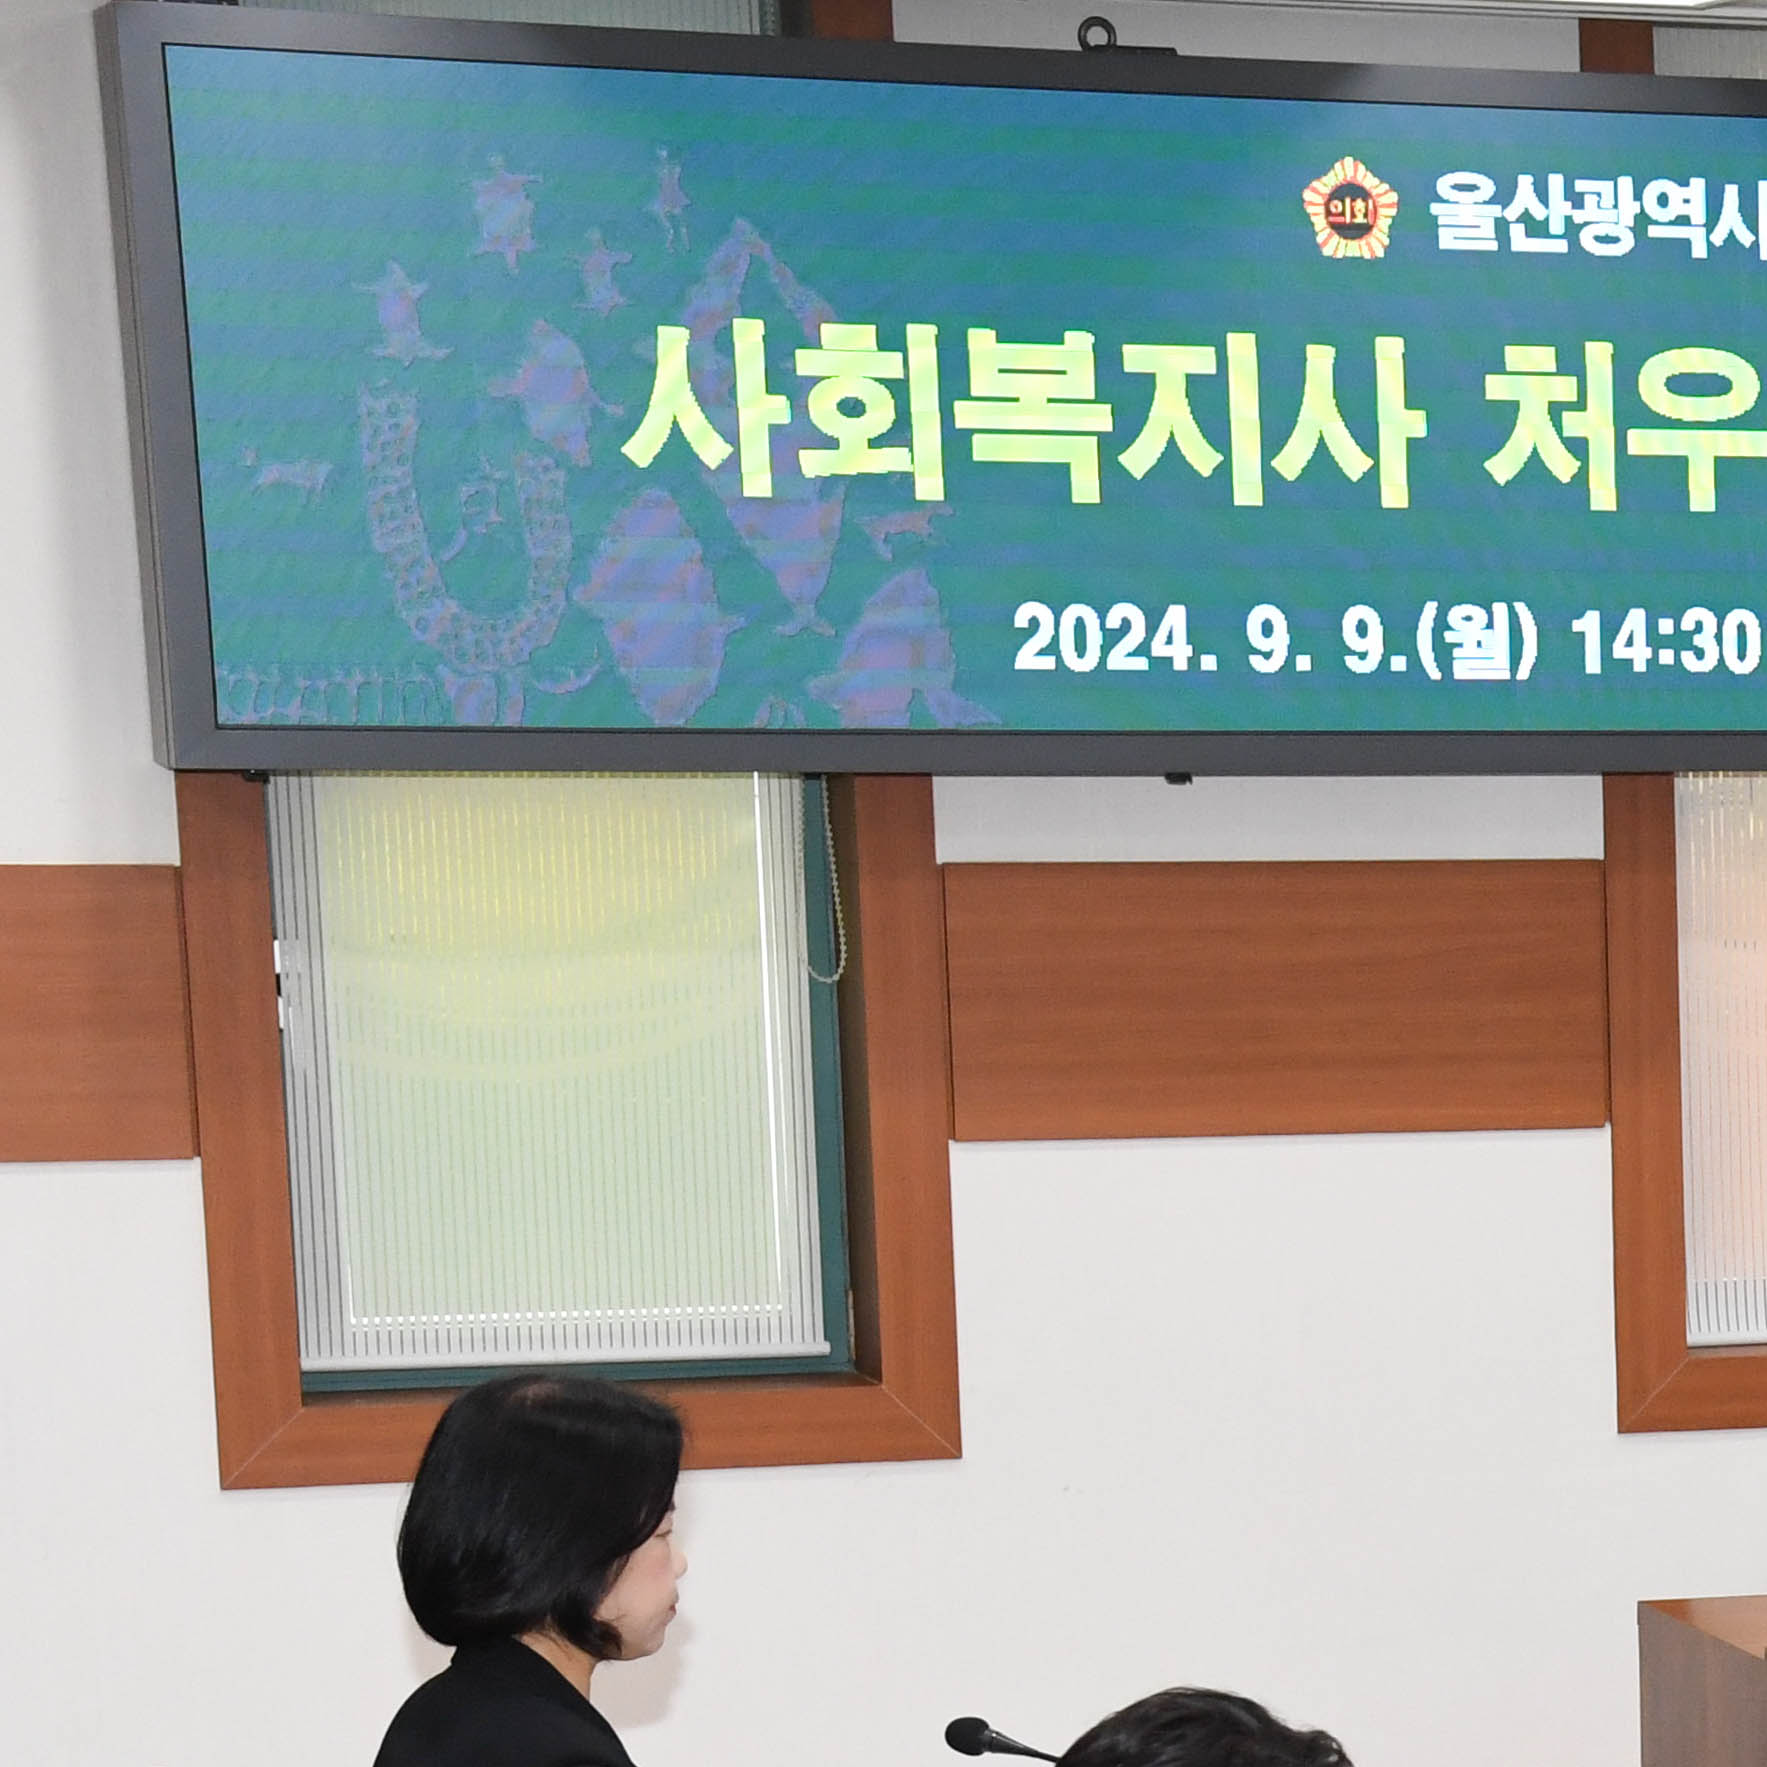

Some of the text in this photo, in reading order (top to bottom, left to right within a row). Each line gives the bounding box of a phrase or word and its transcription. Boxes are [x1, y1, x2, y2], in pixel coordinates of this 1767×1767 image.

[620, 317, 1428, 509] 사회복지사
[1013, 601, 1762, 681] 2024. 9. 9.(월) 14:30
